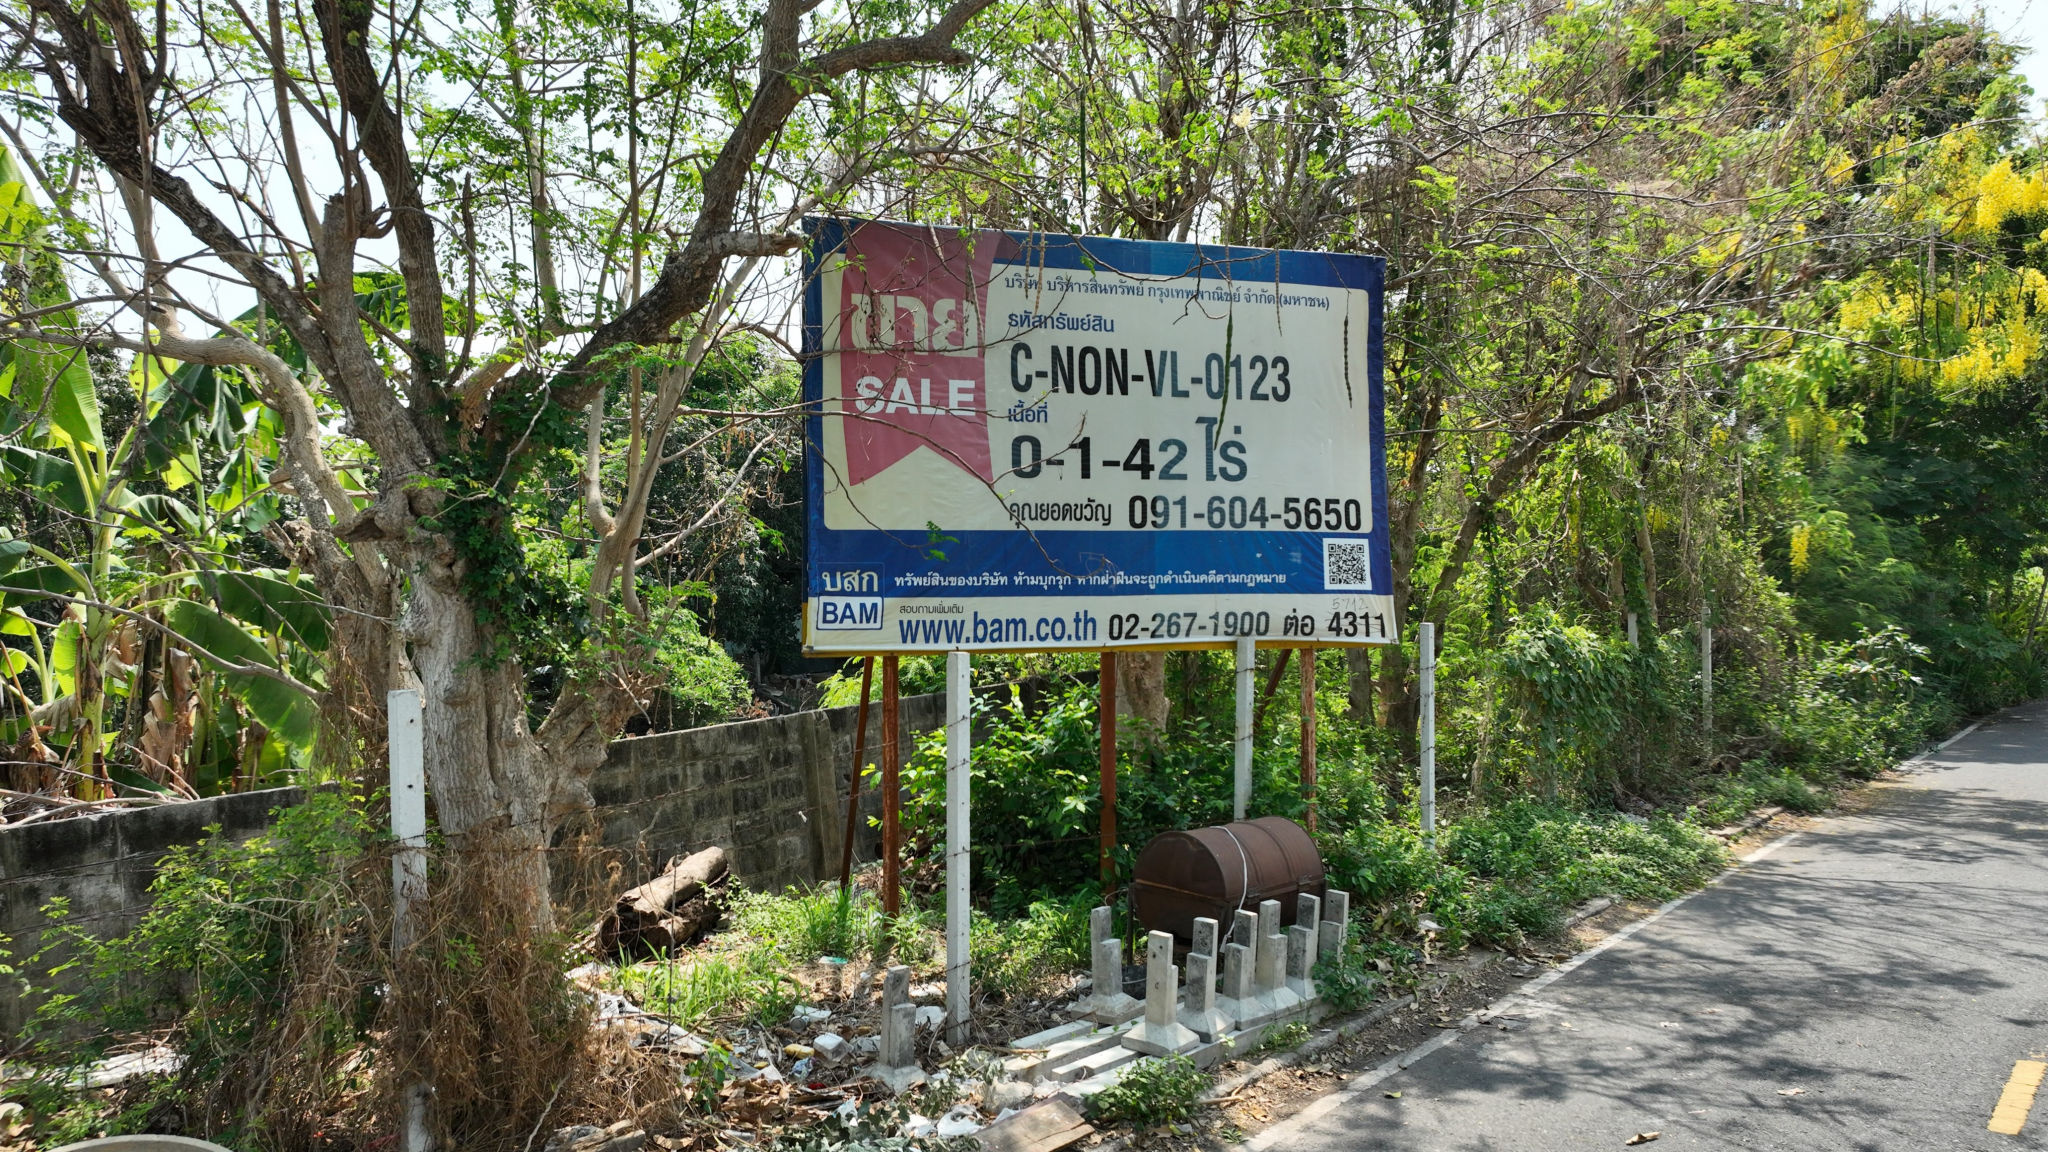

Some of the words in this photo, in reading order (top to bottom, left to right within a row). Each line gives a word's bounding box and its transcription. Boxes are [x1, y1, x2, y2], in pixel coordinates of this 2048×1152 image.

[1279, 293, 1330, 311] (มหาชน)
[851, 293, 978, 358] ขาย
[1008, 309, 1114, 333] รหัสทรัพย์สิน
[1010, 342, 1291, 402] C-NON-VL-0123
[855, 375, 976, 416] SALE
[1008, 399, 1048, 423] เนื้อที่
[1011, 435, 1188, 481] 0-1-42
[1195, 416, 1247, 482] ไร่
[1009, 497, 1112, 529] คุณยอดขวัญ
[1128, 494, 1362, 531] 091-604-5650
[821, 569, 879, 592] บสก
[894, 571, 1008, 587] ทรัพย์สินของบริษัท
[822, 601, 879, 625] BAM
[899, 600, 964, 614] สอบถามเพิ่มเติม
[899, 609, 1097, 645] www.bam.co.th
[1108, 611, 1270, 641] 02-267-1900
[1283, 608, 1315, 636] ต่อ
[1328, 611, 1386, 638] 4311
